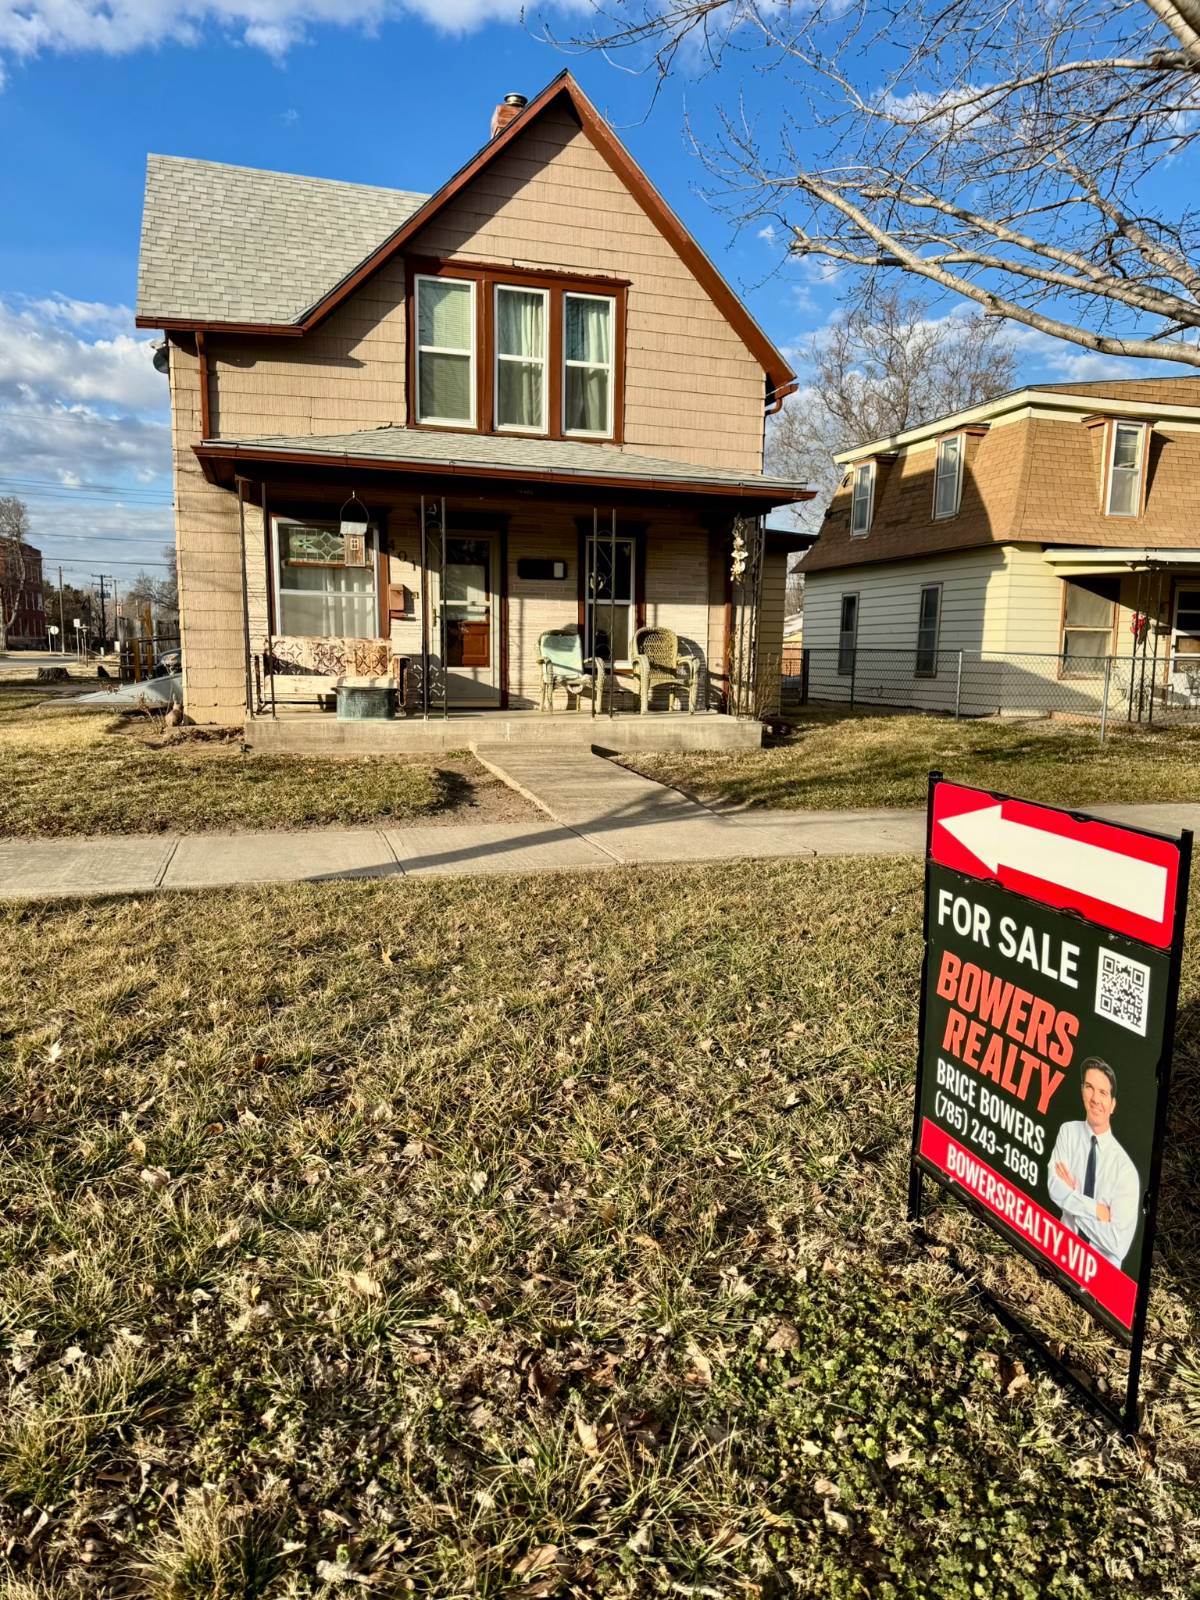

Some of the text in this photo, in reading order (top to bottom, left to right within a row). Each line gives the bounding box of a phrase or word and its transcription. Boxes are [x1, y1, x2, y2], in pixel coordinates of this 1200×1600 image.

[938, 888, 1080, 989] FOR SALE
[936, 950, 1080, 1068] BOWERS
[942, 1007, 1066, 1115] REALTY
[934, 1090, 1039, 1187] (785) 243-1689
[937, 1058, 1046, 1155] BRICE BOWERS
[946, 1142, 1098, 1284] BOWERSREALTY.VIP
